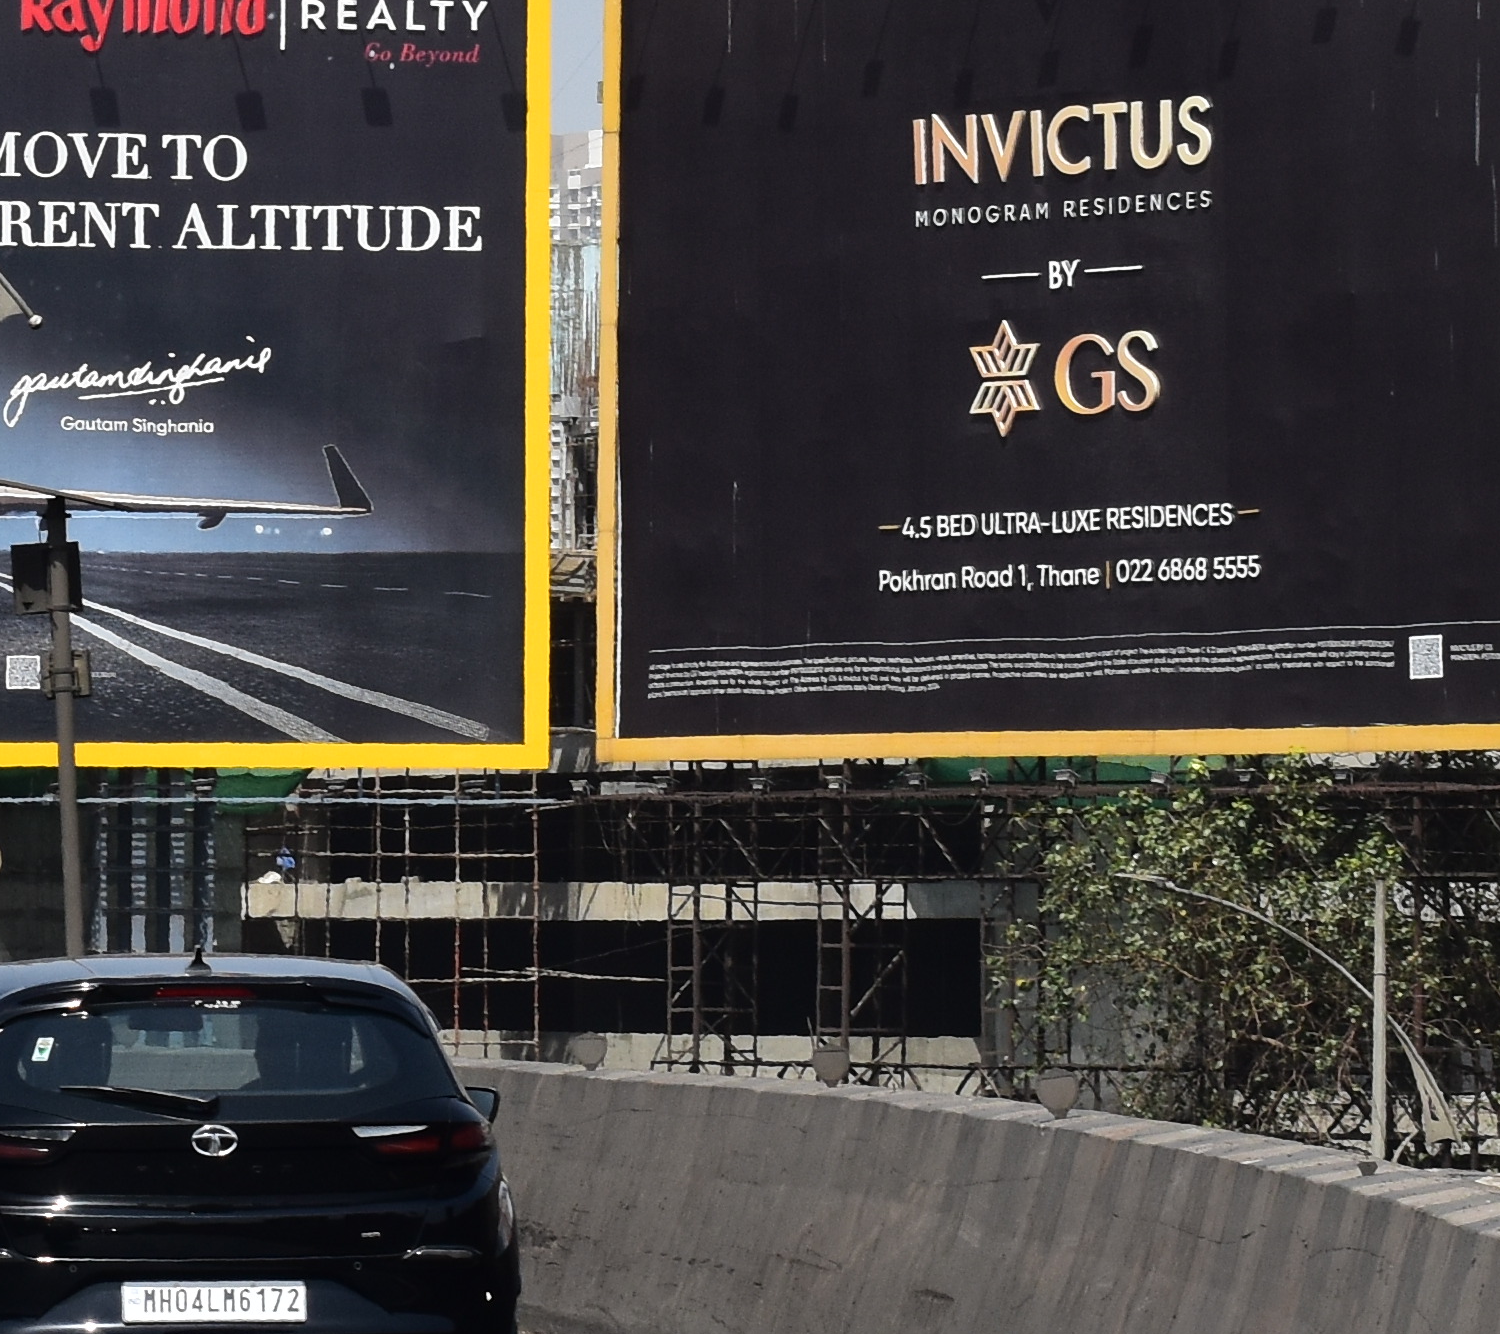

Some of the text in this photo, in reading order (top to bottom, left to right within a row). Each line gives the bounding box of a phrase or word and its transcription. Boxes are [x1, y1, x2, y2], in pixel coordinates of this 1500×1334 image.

[301, 0, 489, 32] REALTY
[364, 42, 481, 67] Go Beyond
[162, 134, 249, 181] TO
[911, 95, 1214, 186] INVICTUS
[173, 202, 483, 252] ALTITUDE
[914, 190, 1214, 228] MONOGRAM RESIDENCES
[1047, 259, 1080, 289] BY
[1054, 330, 1160, 415] GS
[60, 416, 215, 436] Gautam Singhania
[902, 503, 1234, 539] 4.5 BED ULTRA-LUXE RESIDENCES
[879, 564, 956, 592] Pokhran
[962, 563, 1013, 588] Road
[1037, 563, 1100, 588] Thane
[1116, 559, 1153, 583] 022
[1158, 557, 1207, 581] 6868
[1213, 555, 1262, 579] 5555
[143, 1288, 300, 1313] MH04LM6172
